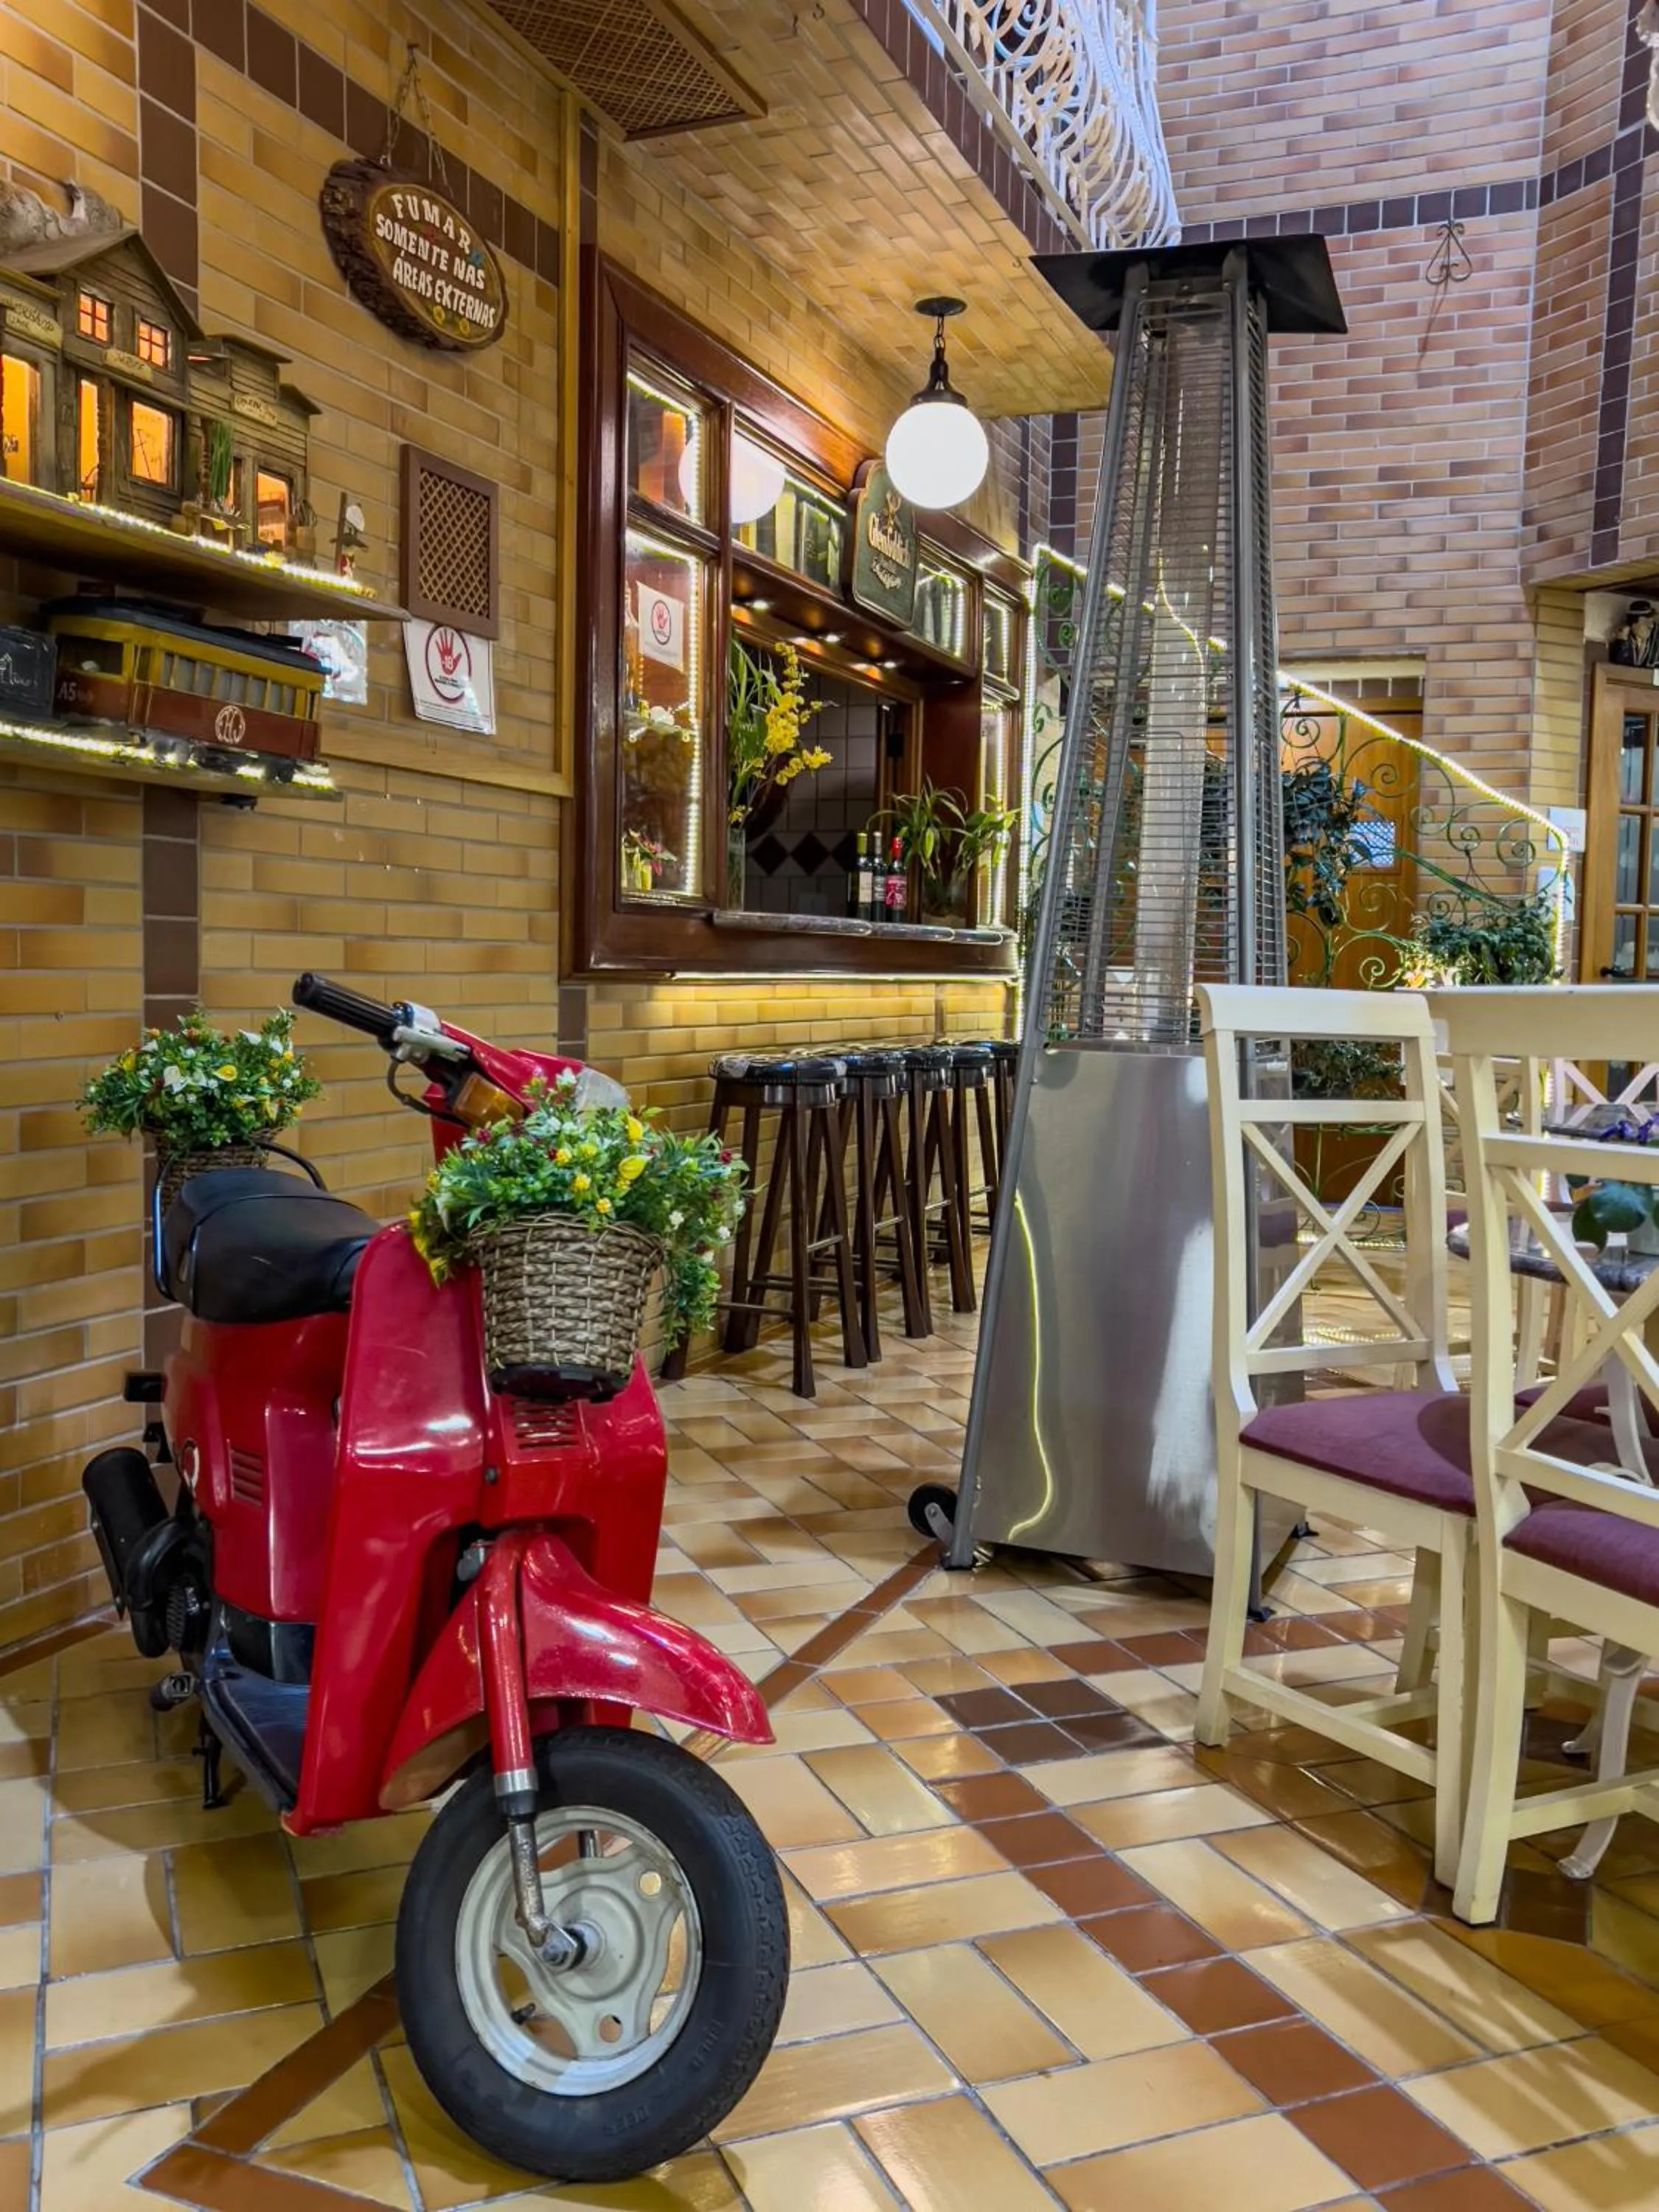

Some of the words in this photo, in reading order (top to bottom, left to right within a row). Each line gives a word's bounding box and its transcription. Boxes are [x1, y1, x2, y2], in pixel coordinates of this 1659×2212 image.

[375, 213, 448, 271] SOMENTE
[453, 257, 484, 290] NAS
[391, 194, 471, 254] FUMAR
[434, 279, 495, 328] EXTERNAS
